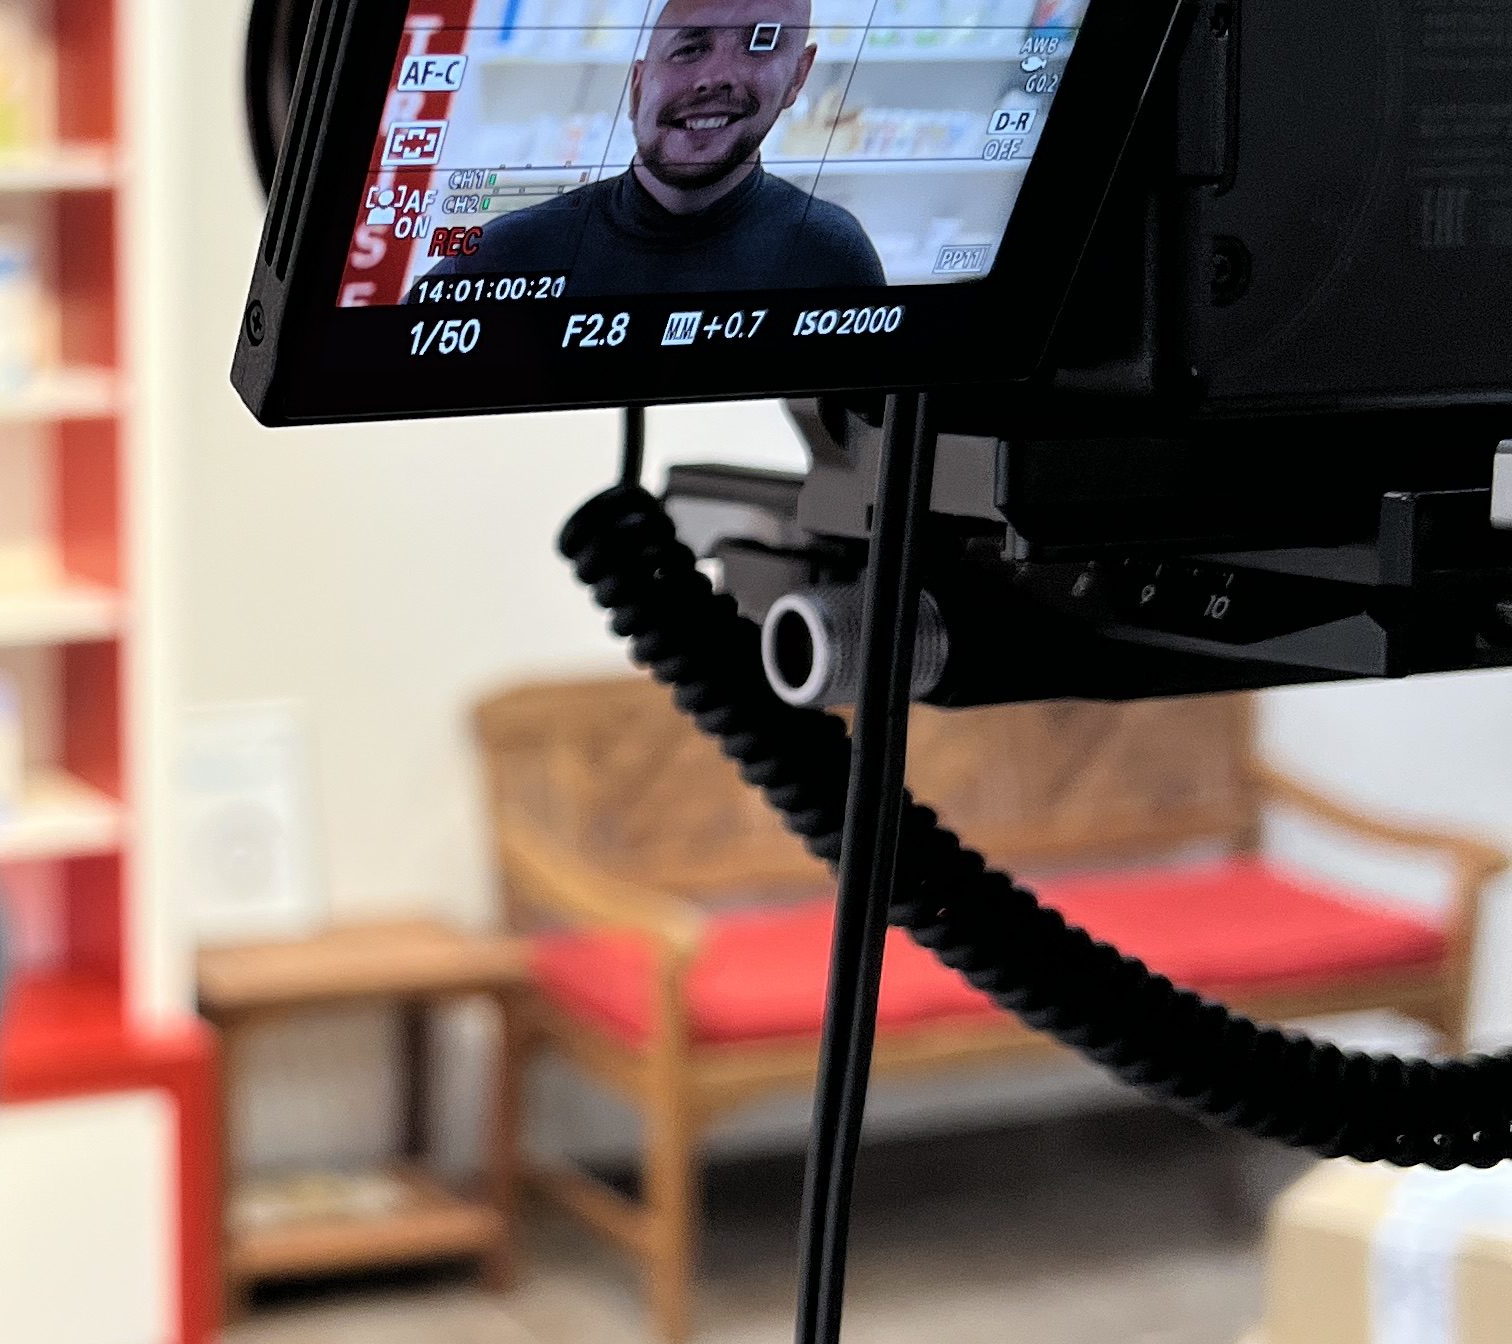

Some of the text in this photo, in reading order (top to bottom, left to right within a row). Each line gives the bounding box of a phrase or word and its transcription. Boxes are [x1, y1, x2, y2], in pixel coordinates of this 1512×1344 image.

[1019, 36, 1059, 54] AWB
[402, 61, 460, 85] AF-C
[995, 112, 1030, 131] D-R
[983, 139, 1023, 161] OFF
[449, 170, 484, 189] CH1
[403, 189, 438, 213] AF
[442, 194, 479, 214] CH2
[395, 216, 431, 238] ON
[428, 226, 483, 257] REC
[562, 312, 630, 348] F2.8
[703, 309, 769, 339] +0.7
[410, 318, 481, 355] 1/50
[1204, 594, 1230, 620] 10
